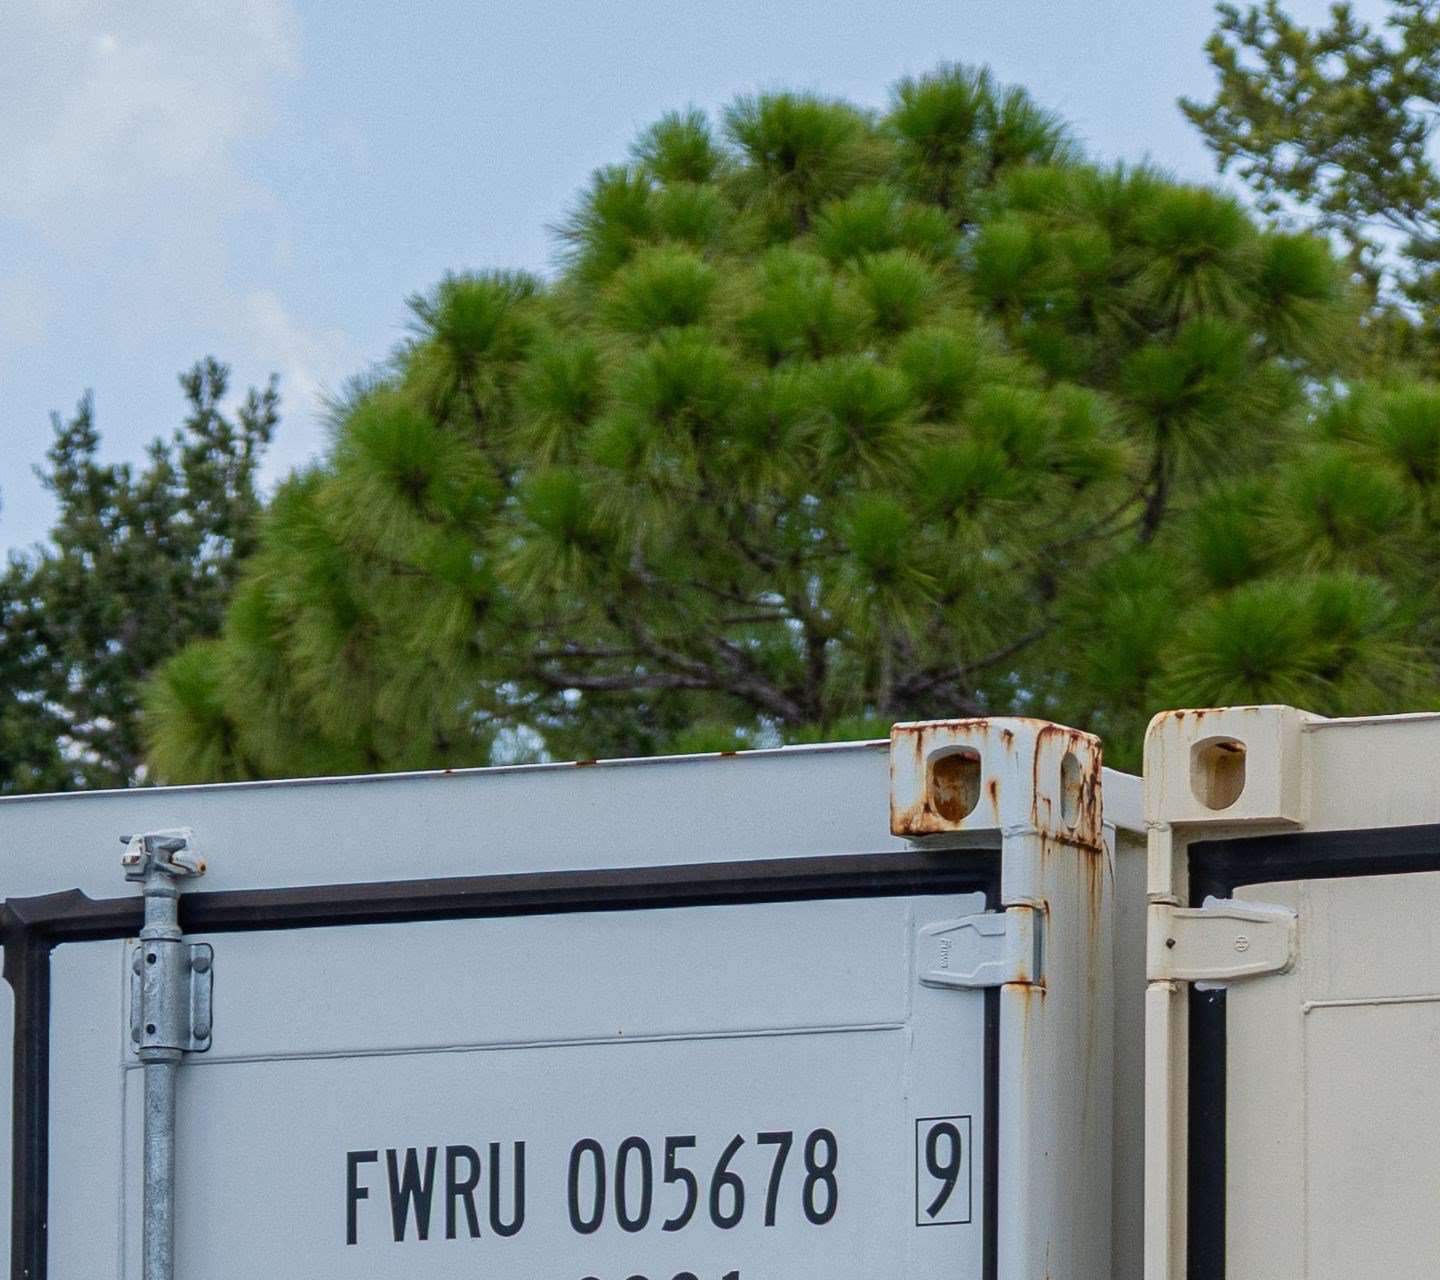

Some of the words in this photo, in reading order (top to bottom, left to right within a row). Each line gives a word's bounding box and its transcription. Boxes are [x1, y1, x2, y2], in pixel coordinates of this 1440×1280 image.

[346, 1140, 526, 1245] FWRU
[568, 1128, 839, 1235] 005678
[925, 1122, 962, 1219] 9
